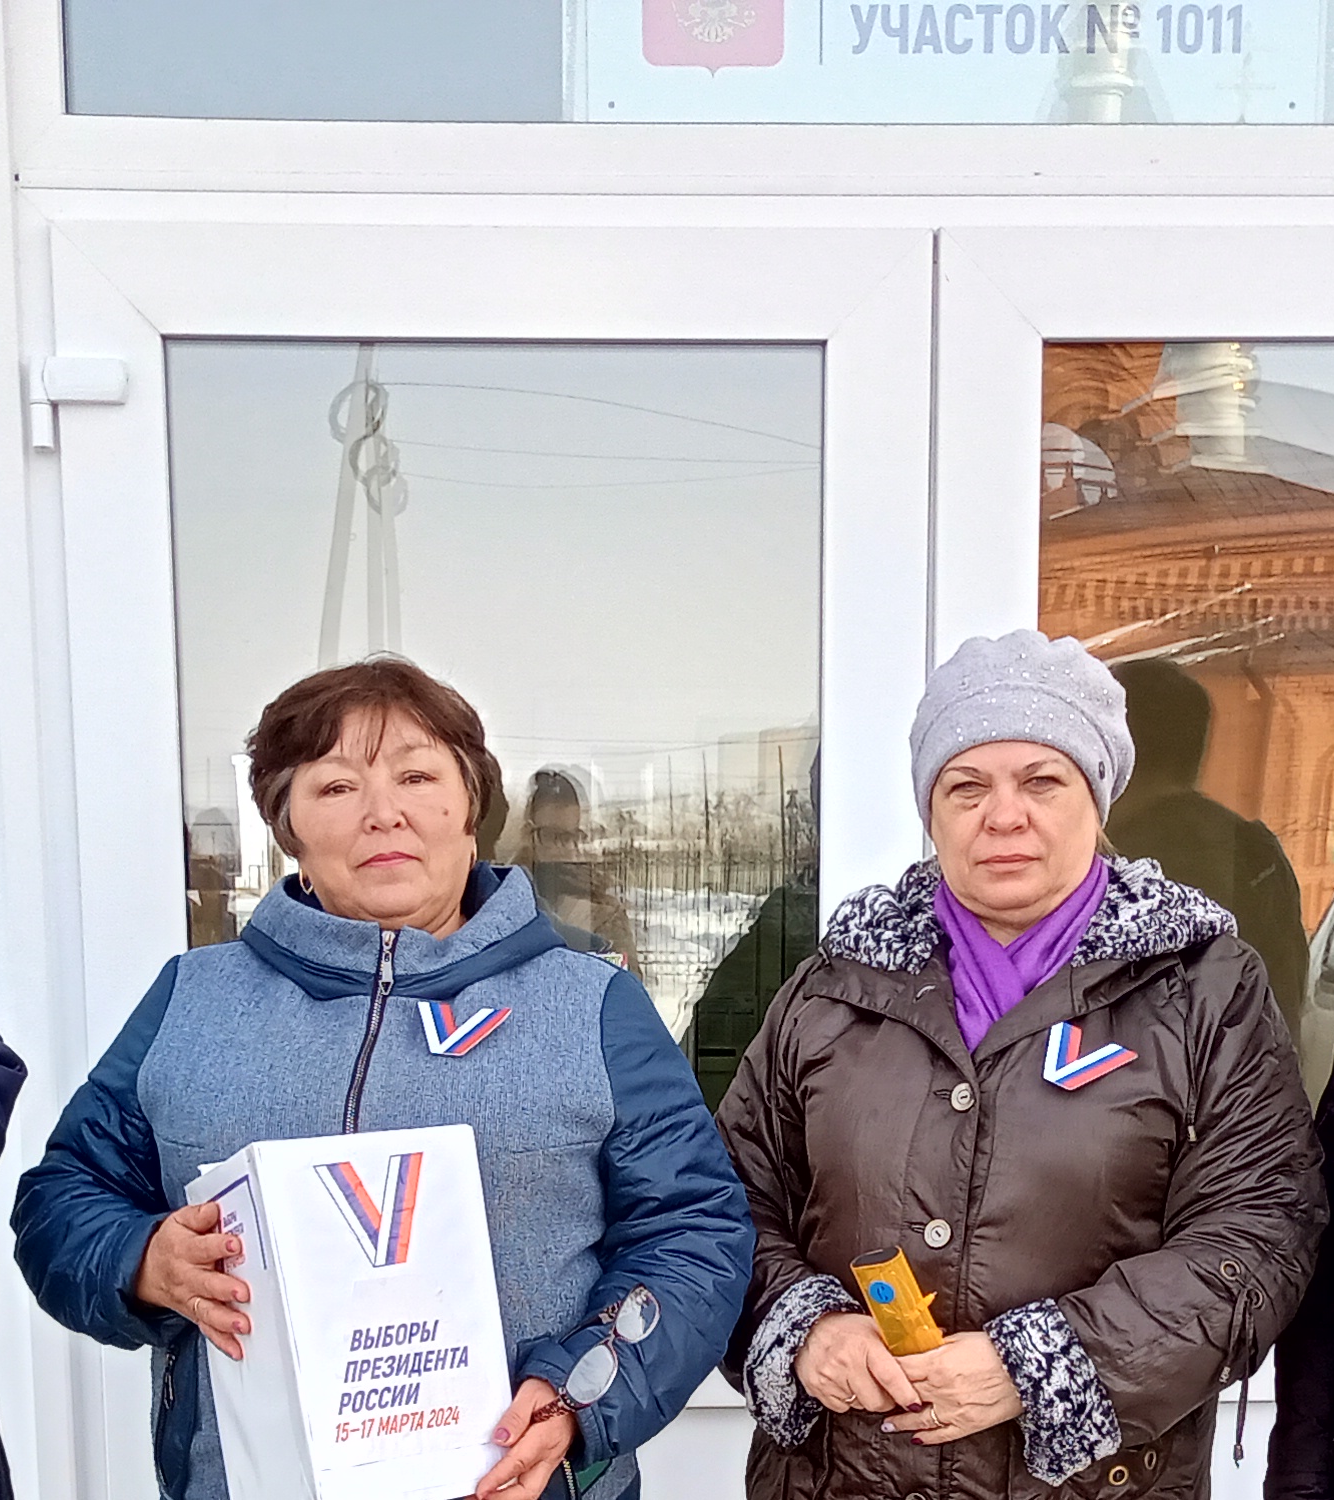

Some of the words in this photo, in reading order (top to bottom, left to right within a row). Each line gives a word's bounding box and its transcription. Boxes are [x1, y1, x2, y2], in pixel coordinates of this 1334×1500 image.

[849, 3, 1070, 55] УЧАСТОК
[1155, 3, 1244, 55] 1011
[349, 1319, 440, 1352] ВЫБОРЫ
[343, 1345, 469, 1384] ПРЕЗИДЕНТА
[337, 1382, 421, 1416] РОССИИ
[376, 1410, 425, 1437] МАРТА
[426, 1405, 460, 1429] 2024
